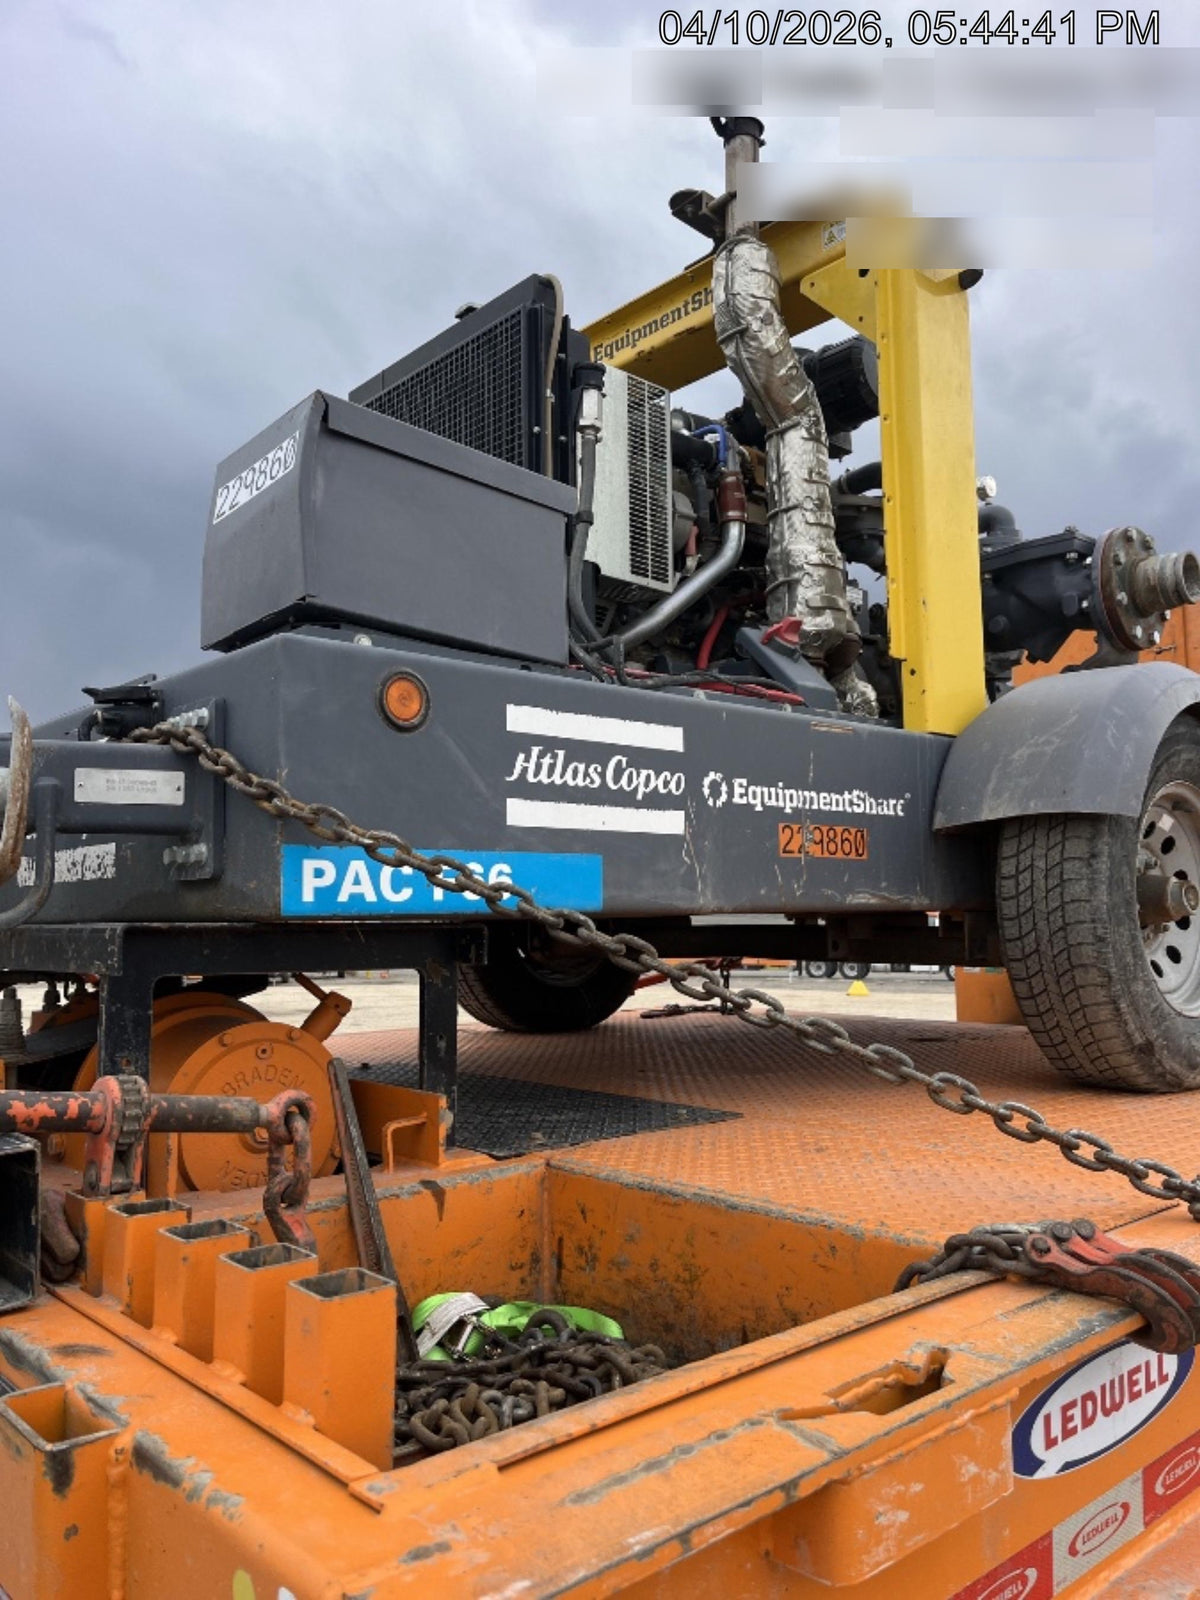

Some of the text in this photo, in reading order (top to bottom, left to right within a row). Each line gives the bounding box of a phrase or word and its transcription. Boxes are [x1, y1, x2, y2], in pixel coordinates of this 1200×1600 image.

[216, 436, 297, 519] 229860
[506, 746, 686, 800] Atlas Copco
[781, 824, 866, 858] 229860
[301, 858, 414, 902] PAC
[1043, 1353, 1169, 1452] LEDWELL
[1081, 1512, 1119, 1546] LEDWELL
